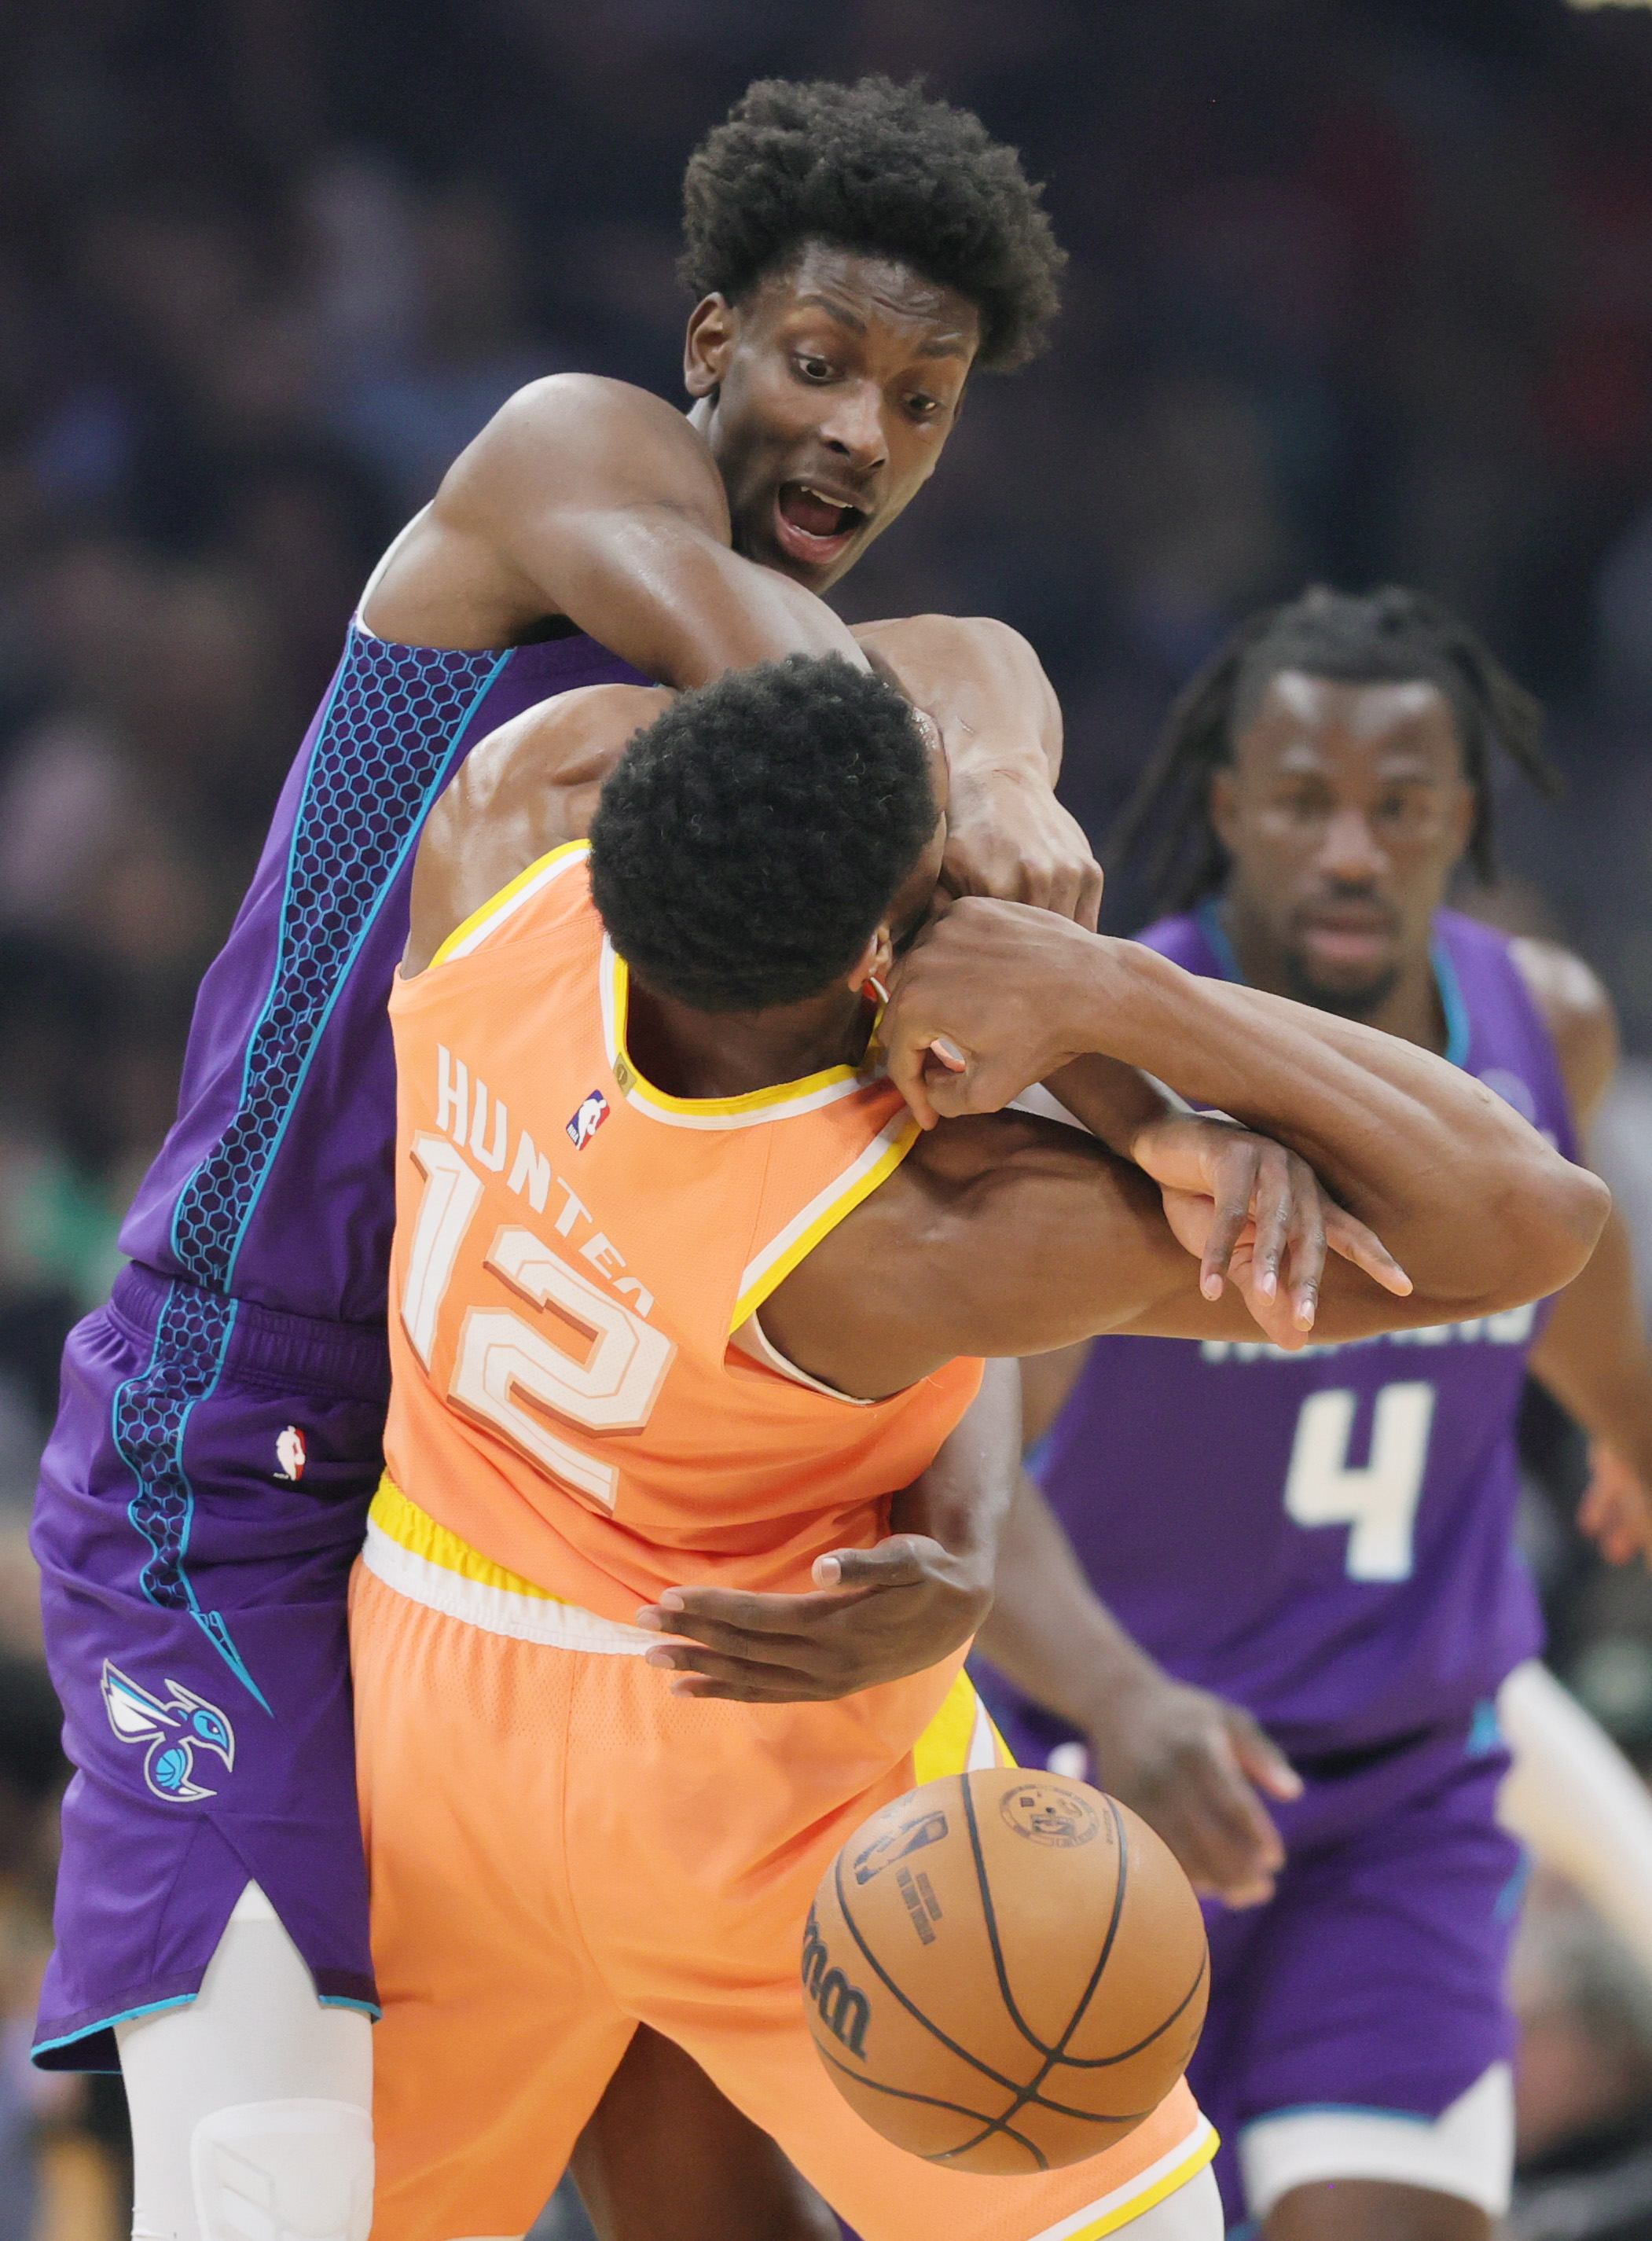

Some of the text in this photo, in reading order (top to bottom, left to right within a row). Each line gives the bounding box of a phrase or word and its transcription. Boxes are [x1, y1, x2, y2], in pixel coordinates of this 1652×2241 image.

[567, 1123, 579, 1143] NBA
[401, 1130, 677, 1517] 12
[1283, 1381, 1436, 1582] 4
